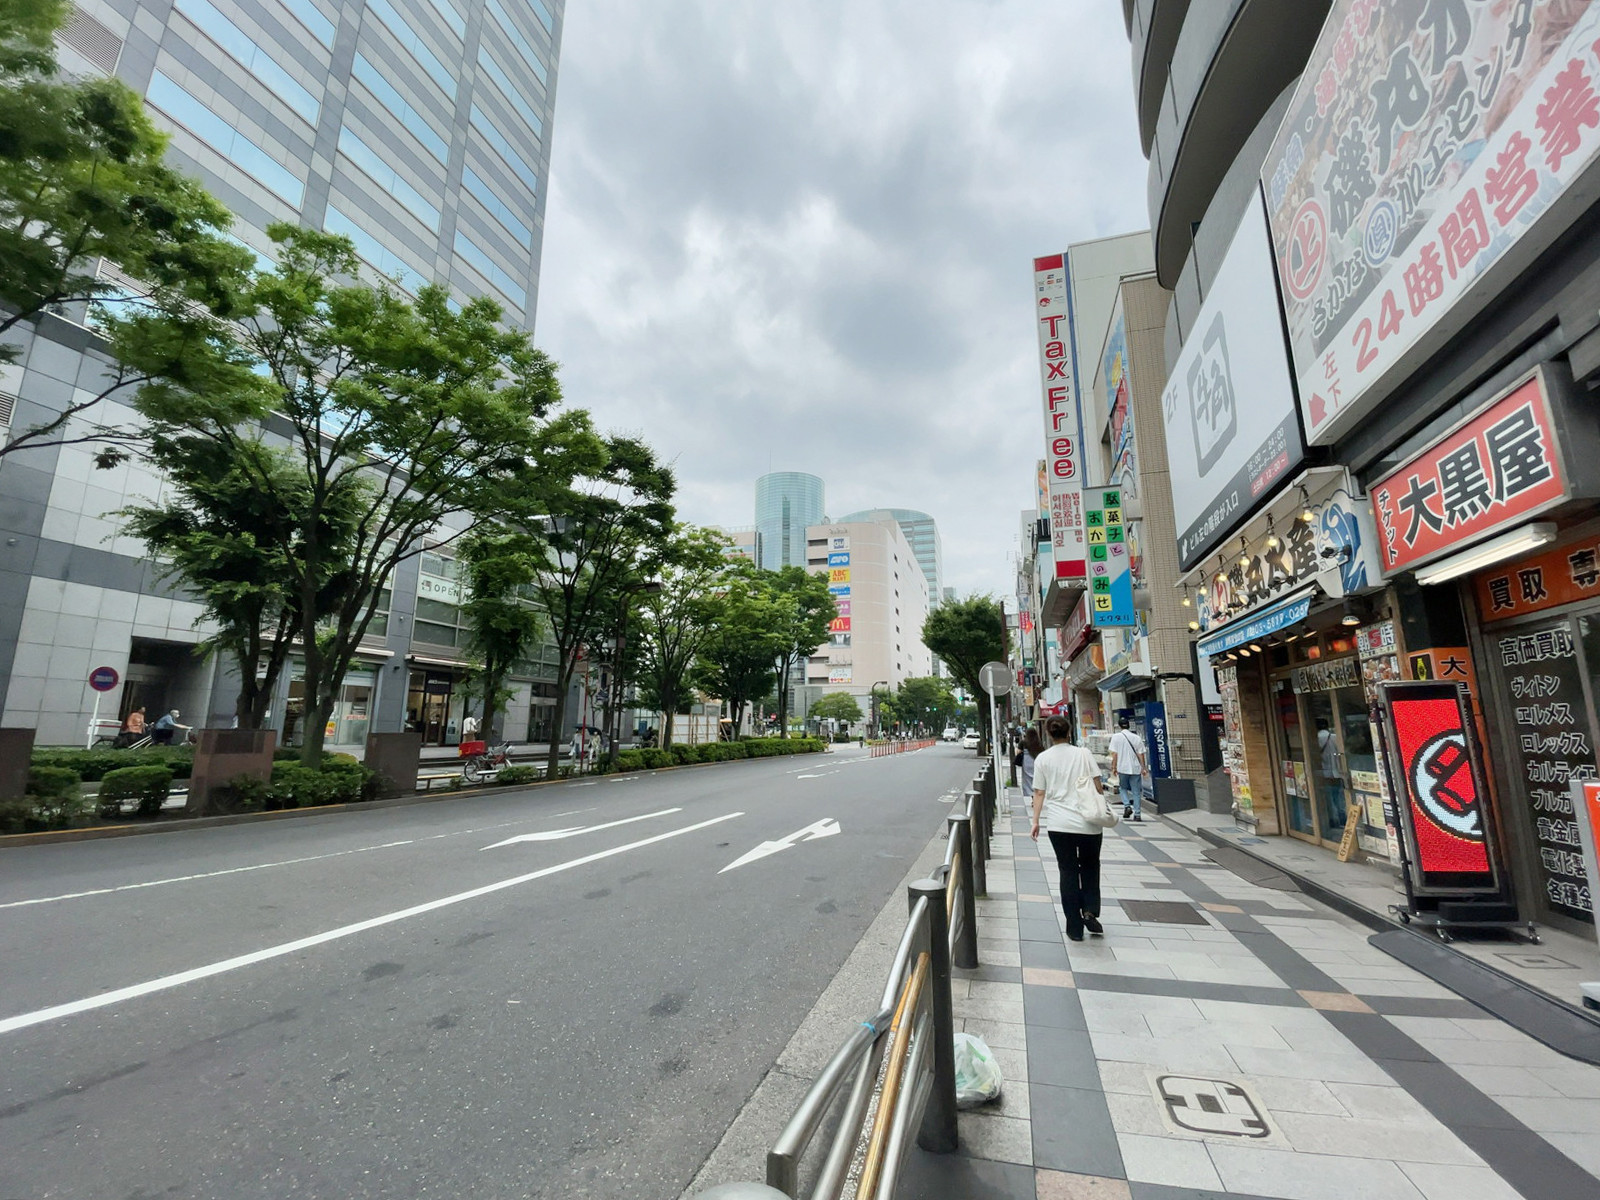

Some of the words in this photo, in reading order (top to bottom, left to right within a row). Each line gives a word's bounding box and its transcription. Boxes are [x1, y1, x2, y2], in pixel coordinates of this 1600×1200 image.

[1040, 315, 1069, 381] Tax
[1165, 384, 1178, 425] 2F
[1048, 386, 1075, 479] Free
[1397, 400, 1554, 549] 大黒屋
[1377, 487, 1398, 565] チケット
[1089, 513, 1110, 609] おかしのみせ
[434, 584, 459, 597] OPEN
[1488, 567, 1548, 612] 買取
[1499, 623, 1576, 666] 高価買取
[1511, 675, 1560, 698] ヴィトン
[1517, 703, 1575, 726] エルメス
[1521, 732, 1590, 755] ロレックス
[1527, 760, 1597, 784] カルティエ
